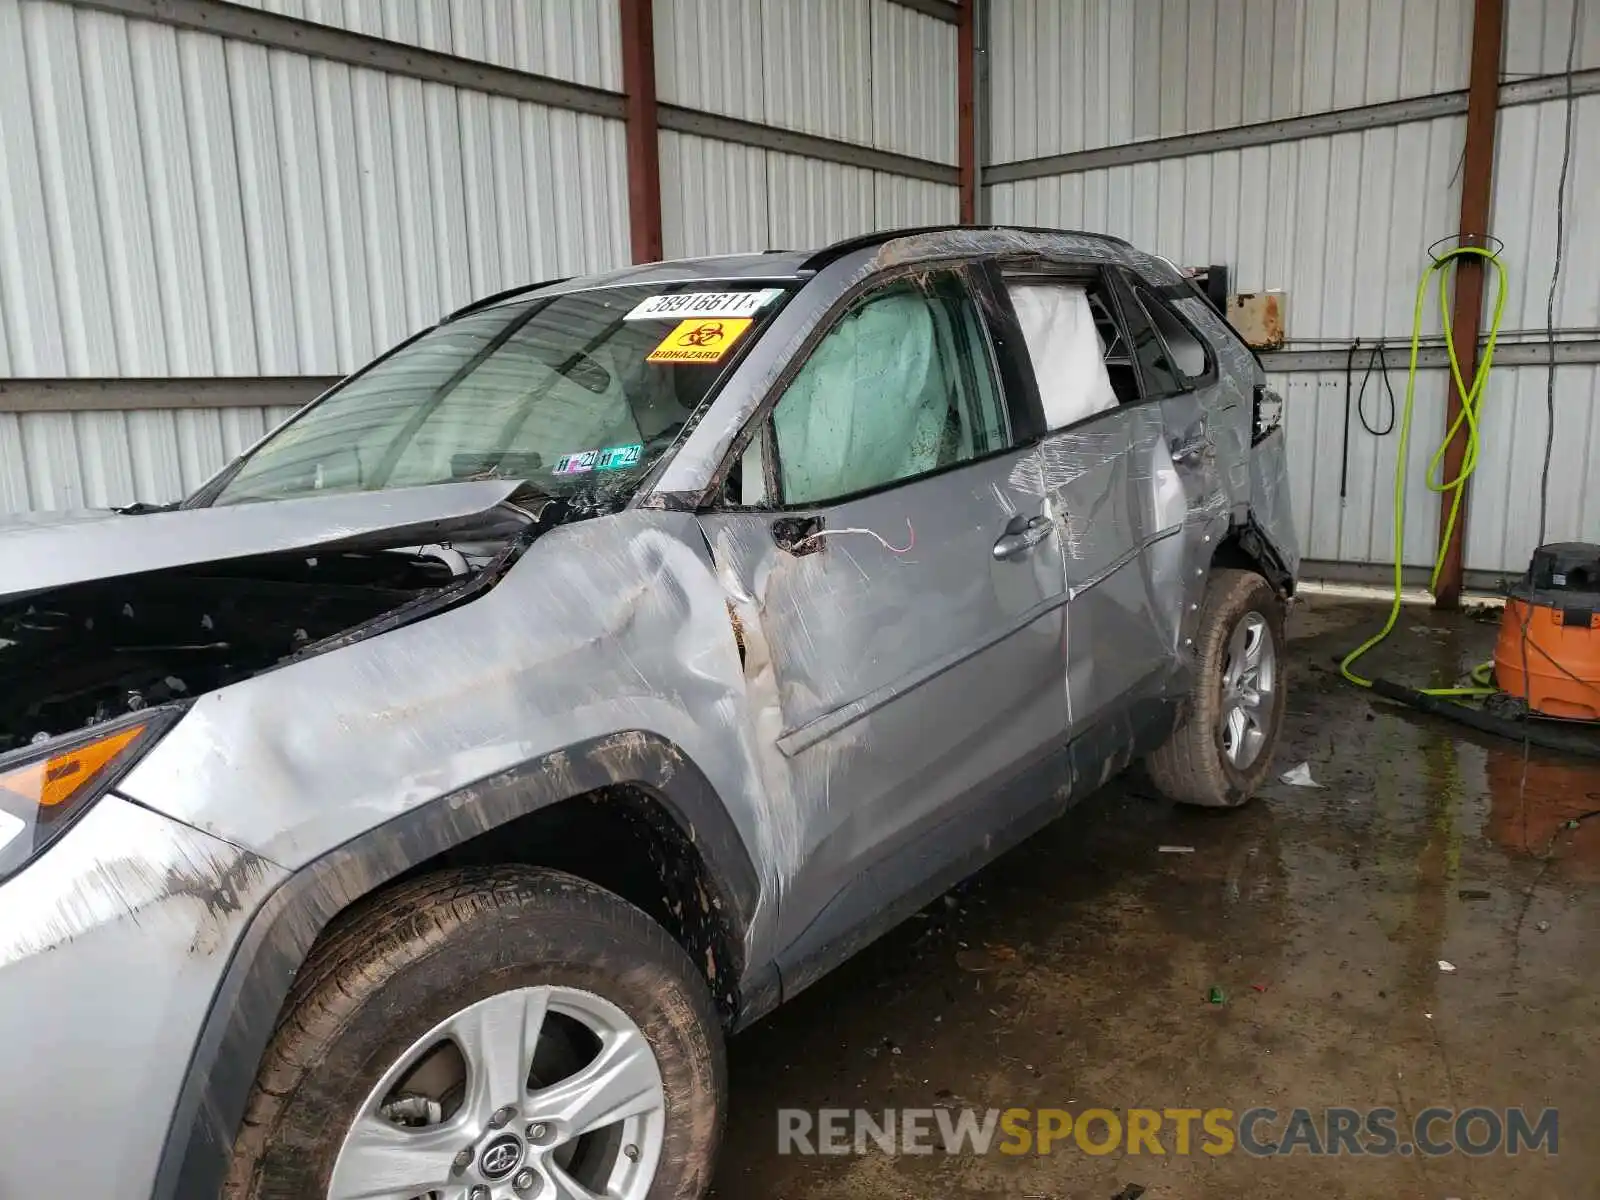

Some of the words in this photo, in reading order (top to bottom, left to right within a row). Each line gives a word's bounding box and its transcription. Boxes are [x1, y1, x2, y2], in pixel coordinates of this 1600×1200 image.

[652, 350, 721, 359] BIOHAZARD
[581, 452, 597, 467] 21
[625, 446, 640, 461] 21
